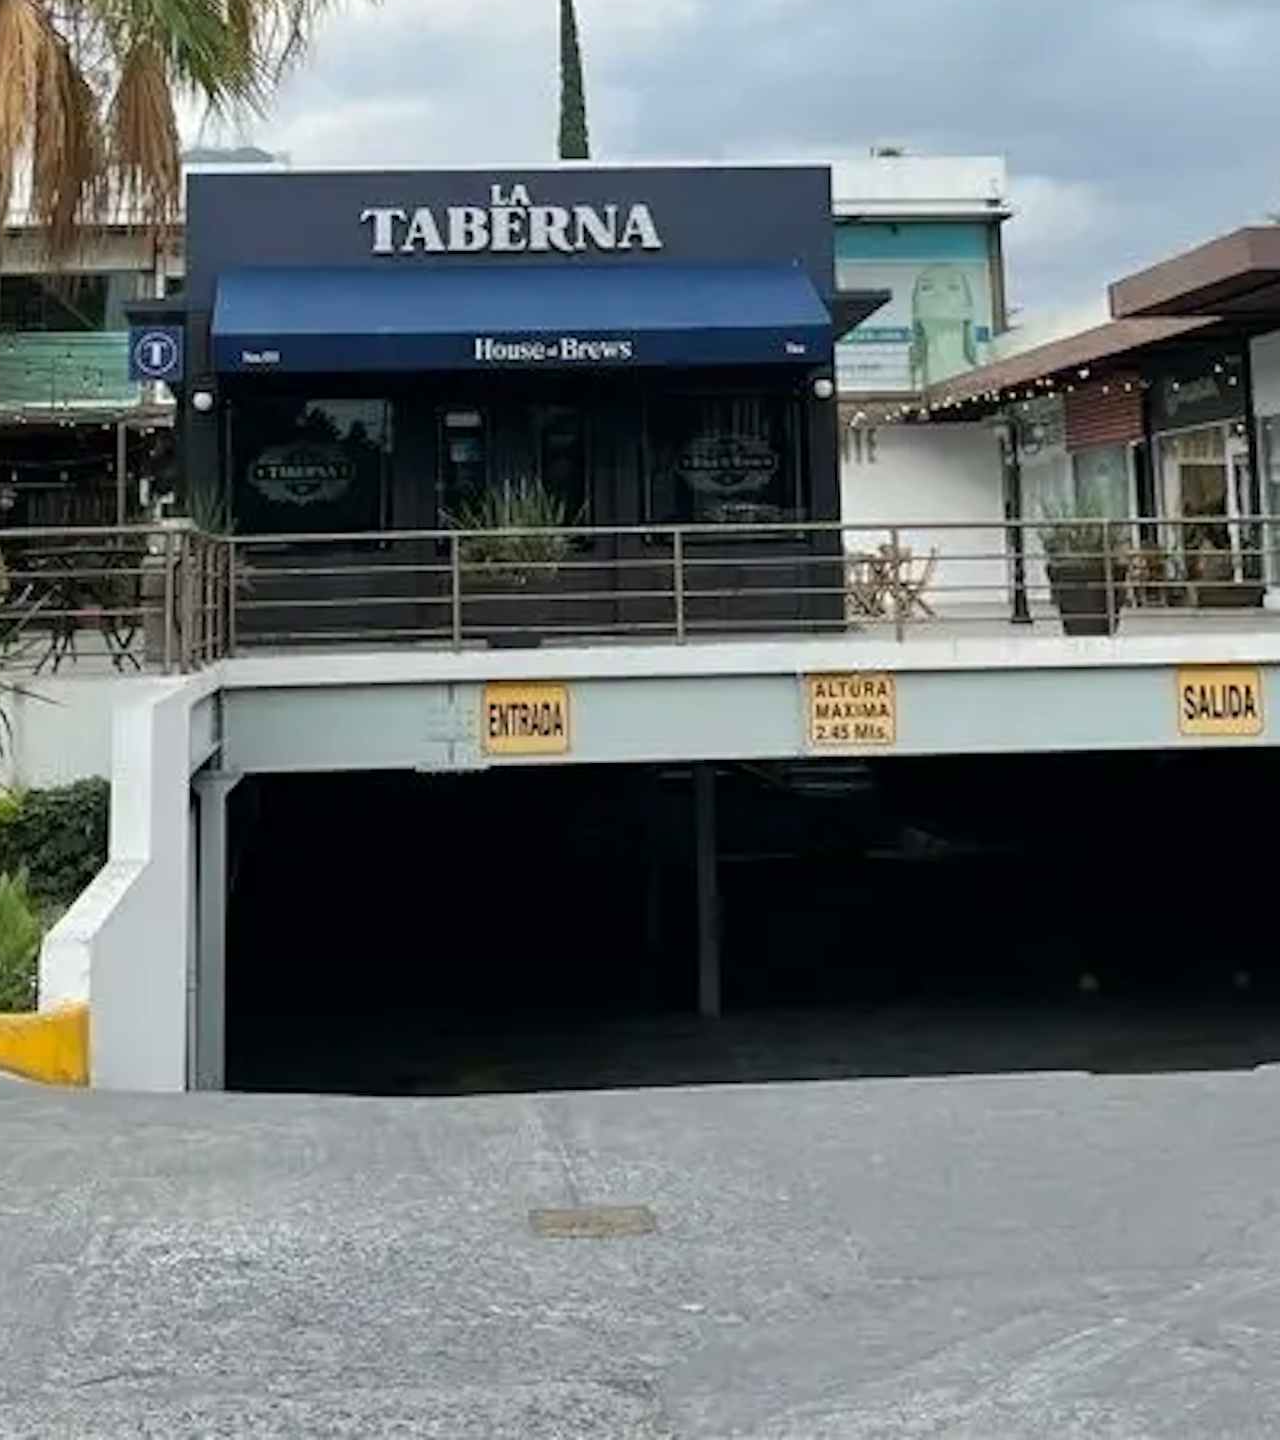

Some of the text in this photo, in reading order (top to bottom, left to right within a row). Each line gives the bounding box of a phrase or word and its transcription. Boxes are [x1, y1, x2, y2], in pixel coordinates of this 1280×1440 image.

[490, 183, 530, 207] LA
[359, 203, 663, 252] TABERNA
[143, 341, 170, 366] T
[475, 337, 544, 361] House
[560, 337, 634, 361] Brews
[815, 681, 887, 697] ALTURA
[1183, 684, 1257, 720] SALIDA
[489, 703, 564, 737] ENTRADA
